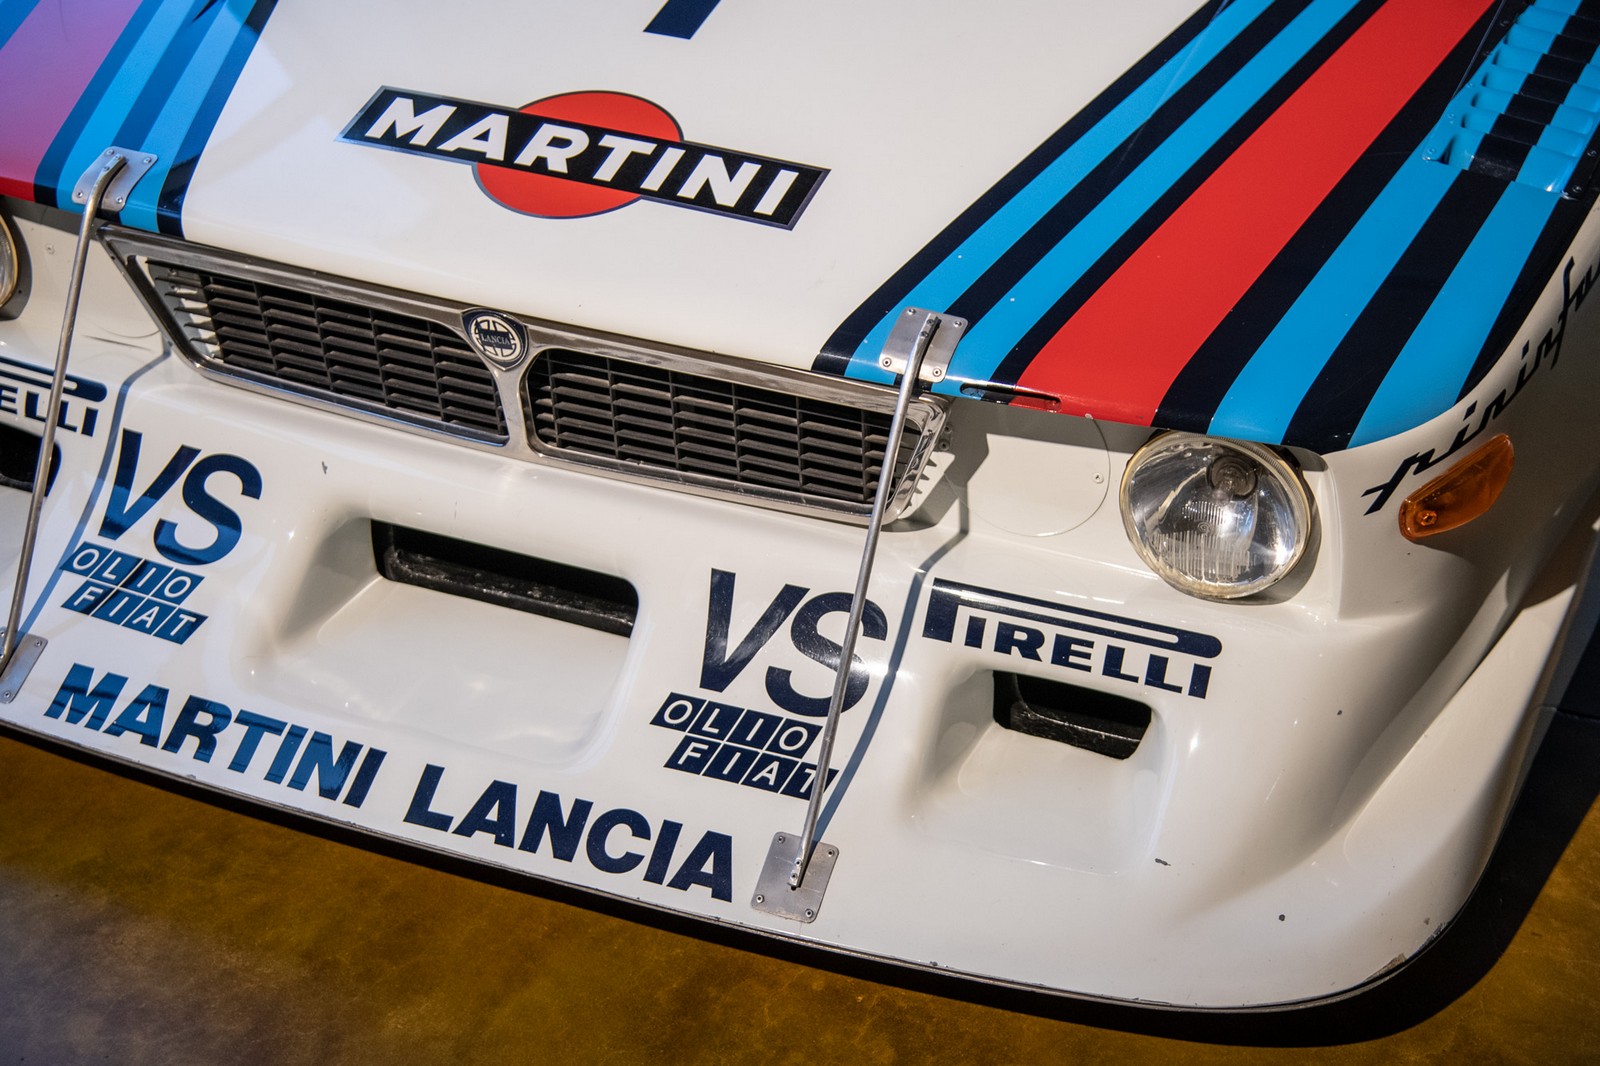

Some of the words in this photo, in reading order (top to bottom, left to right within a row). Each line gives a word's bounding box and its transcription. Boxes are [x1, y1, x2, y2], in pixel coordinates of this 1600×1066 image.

[364, 97, 799, 215] MARTINI
[481, 333, 511, 345] LANCIA
[98, 428, 263, 566] VS
[72, 548, 192, 599] OLIO
[73, 586, 197, 636] FIAT
[699, 568, 888, 717] VS
[922, 577, 1223, 699] PIRELLI
[663, 700, 808, 751] OLIO
[677, 741, 818, 793] FIAT
[44, 663, 387, 808] MARTINI
[403, 763, 733, 902] LANCIA
